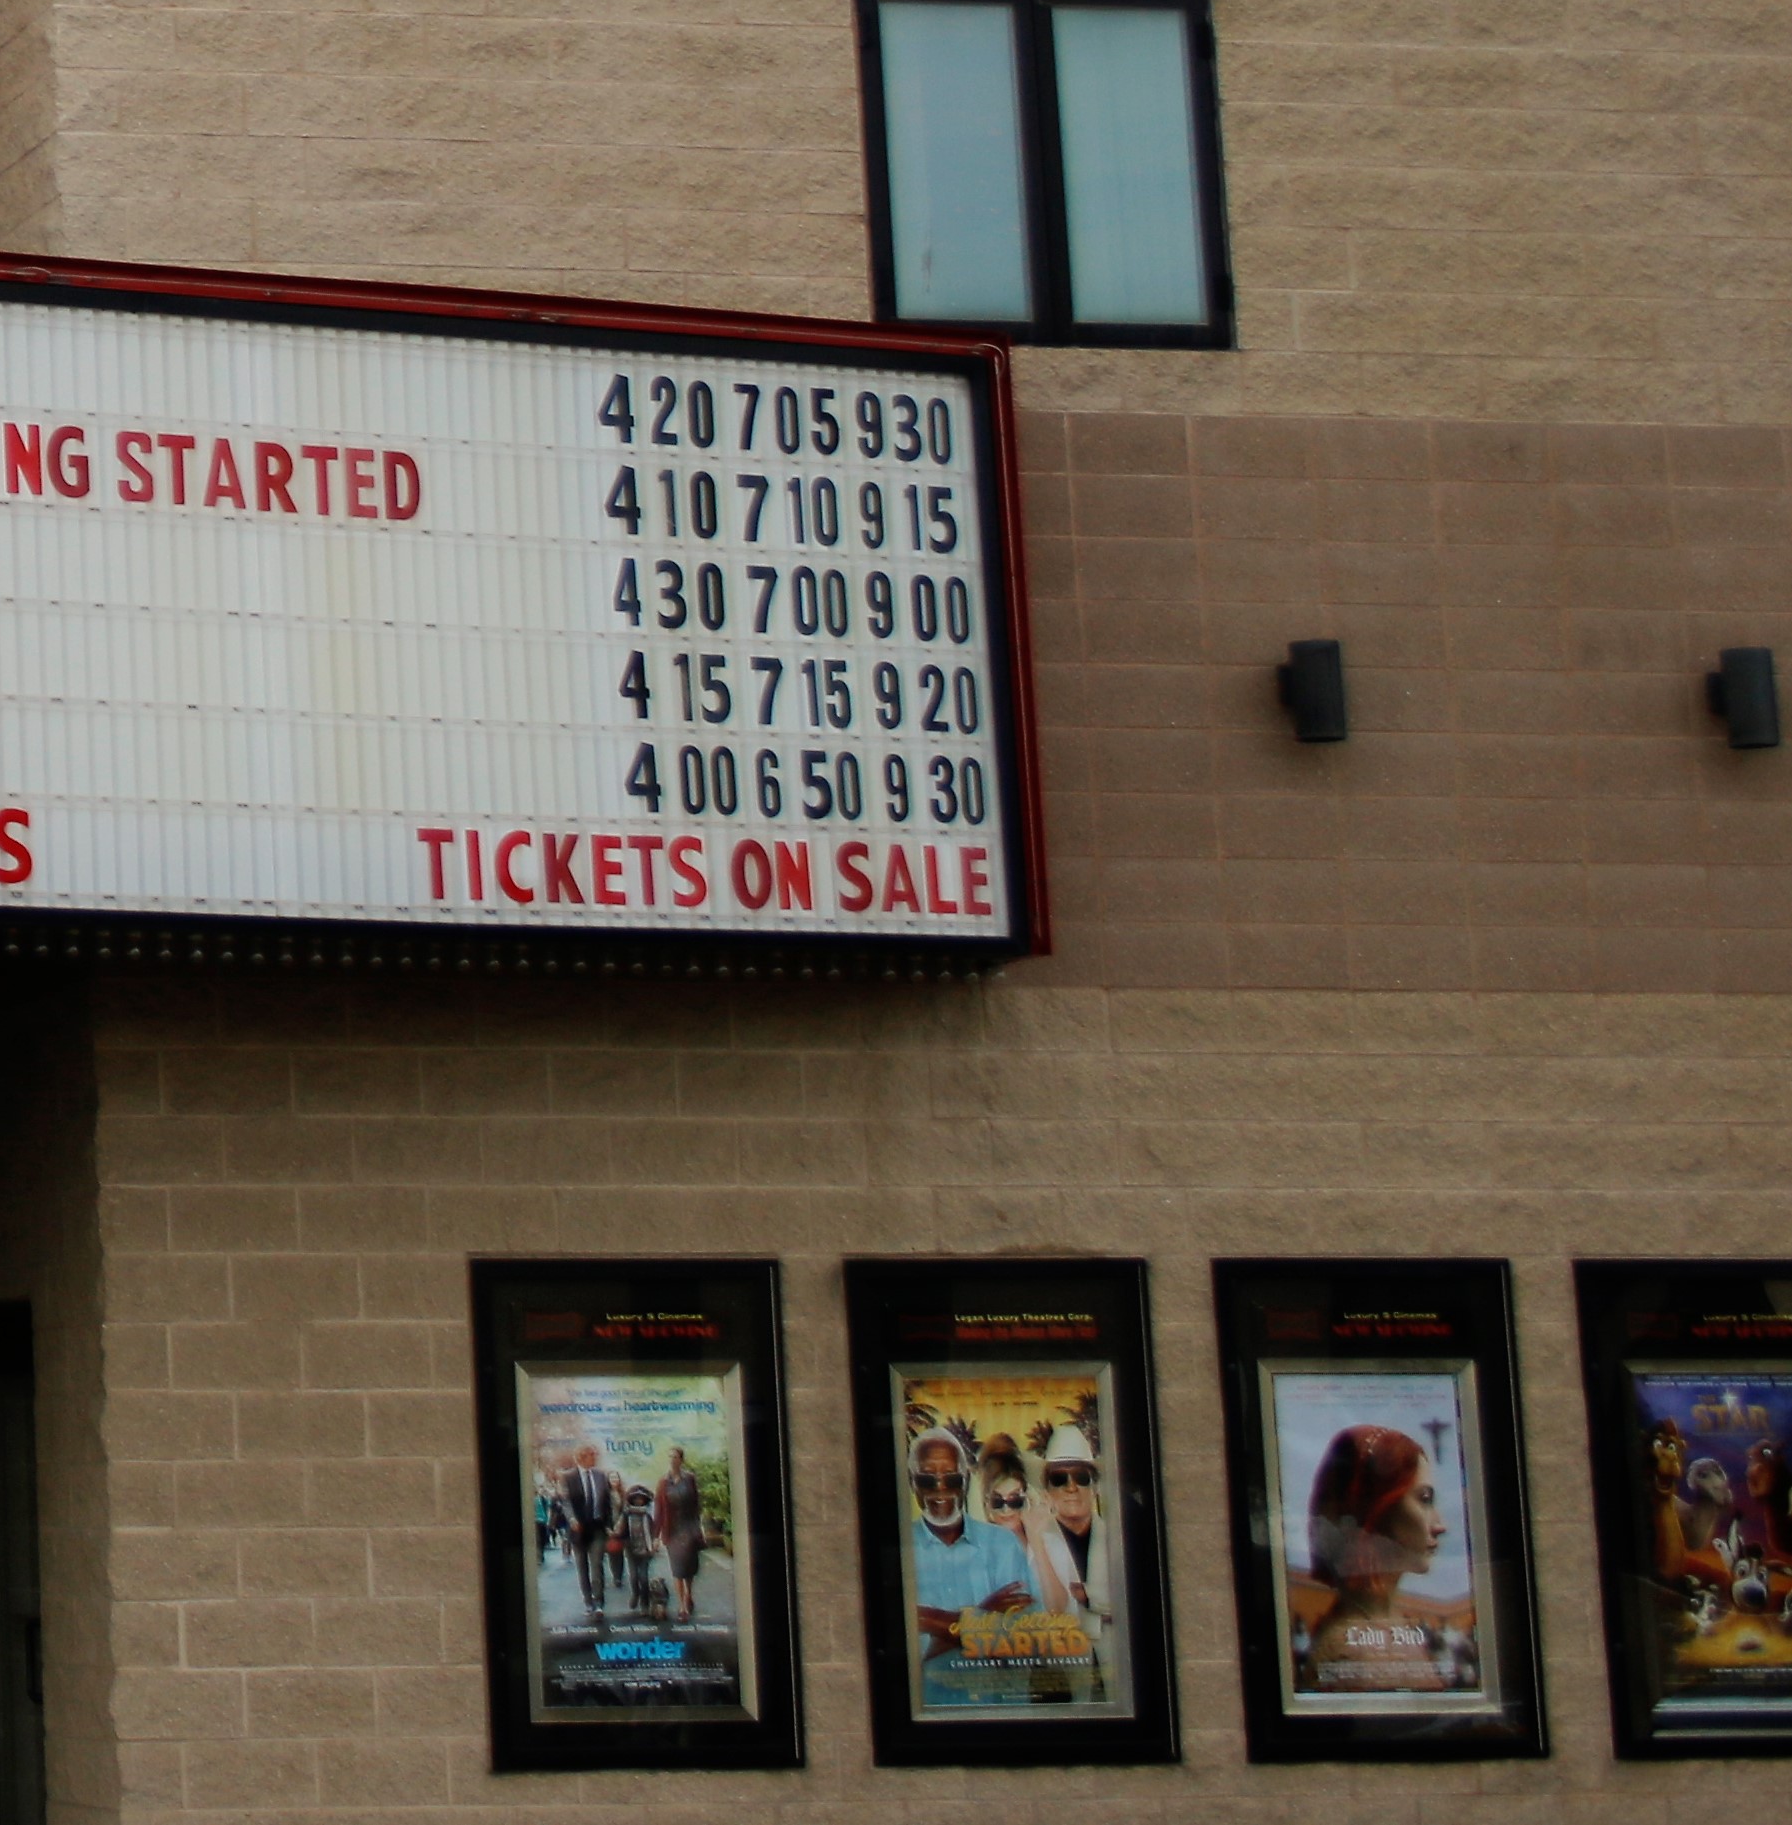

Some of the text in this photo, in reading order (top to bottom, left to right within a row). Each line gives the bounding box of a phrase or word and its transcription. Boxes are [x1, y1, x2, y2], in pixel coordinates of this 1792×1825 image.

[117, 432, 420, 520] STARTED
[418, 829, 991, 915] TICKETS ON SALE
[606, 1313, 642, 1321] Luxury
[955, 1314, 983, 1323] Logan
[988, 1314, 1019, 1322] Luxury
[1068, 1313, 1093, 1321] Corp.
[1344, 1312, 1379, 1320] Luxury
[539, 1402, 602, 1413] wondrous
[624, 1400, 715, 1414] heartwarming
[595, 1636, 685, 1660] wonder
[961, 1629, 1089, 1658] STARTED
[1345, 1626, 1425, 1650] Lady Bird
